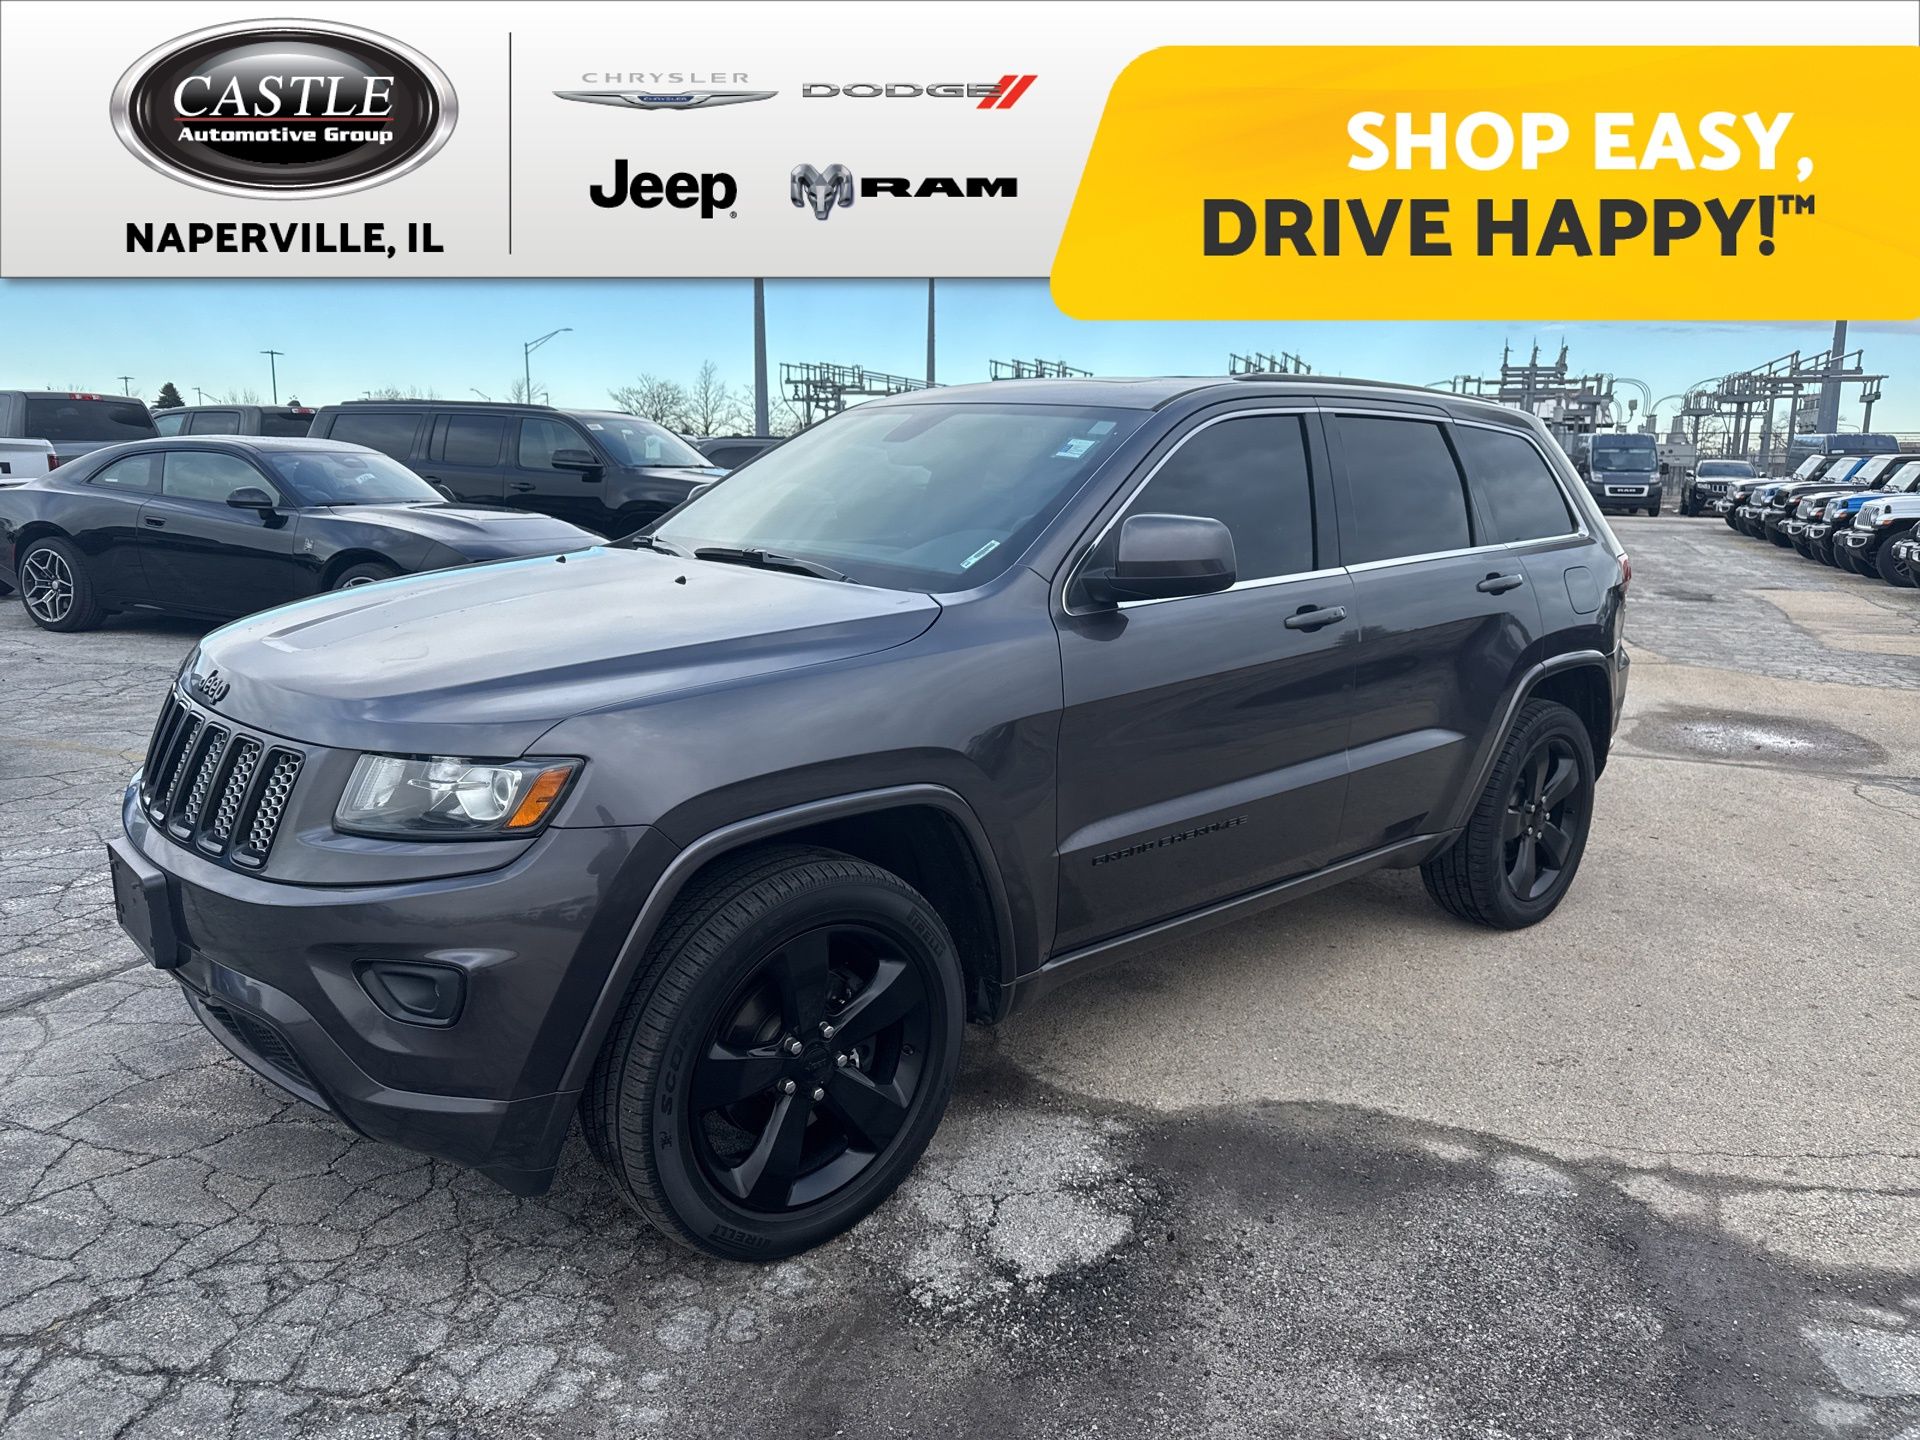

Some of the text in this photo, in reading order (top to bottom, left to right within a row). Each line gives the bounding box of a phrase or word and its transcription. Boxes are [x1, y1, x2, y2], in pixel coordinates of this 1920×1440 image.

[199, 670, 230, 705] Jeep
[1092, 815, 1248, 866] GRAND CHEROKEE
